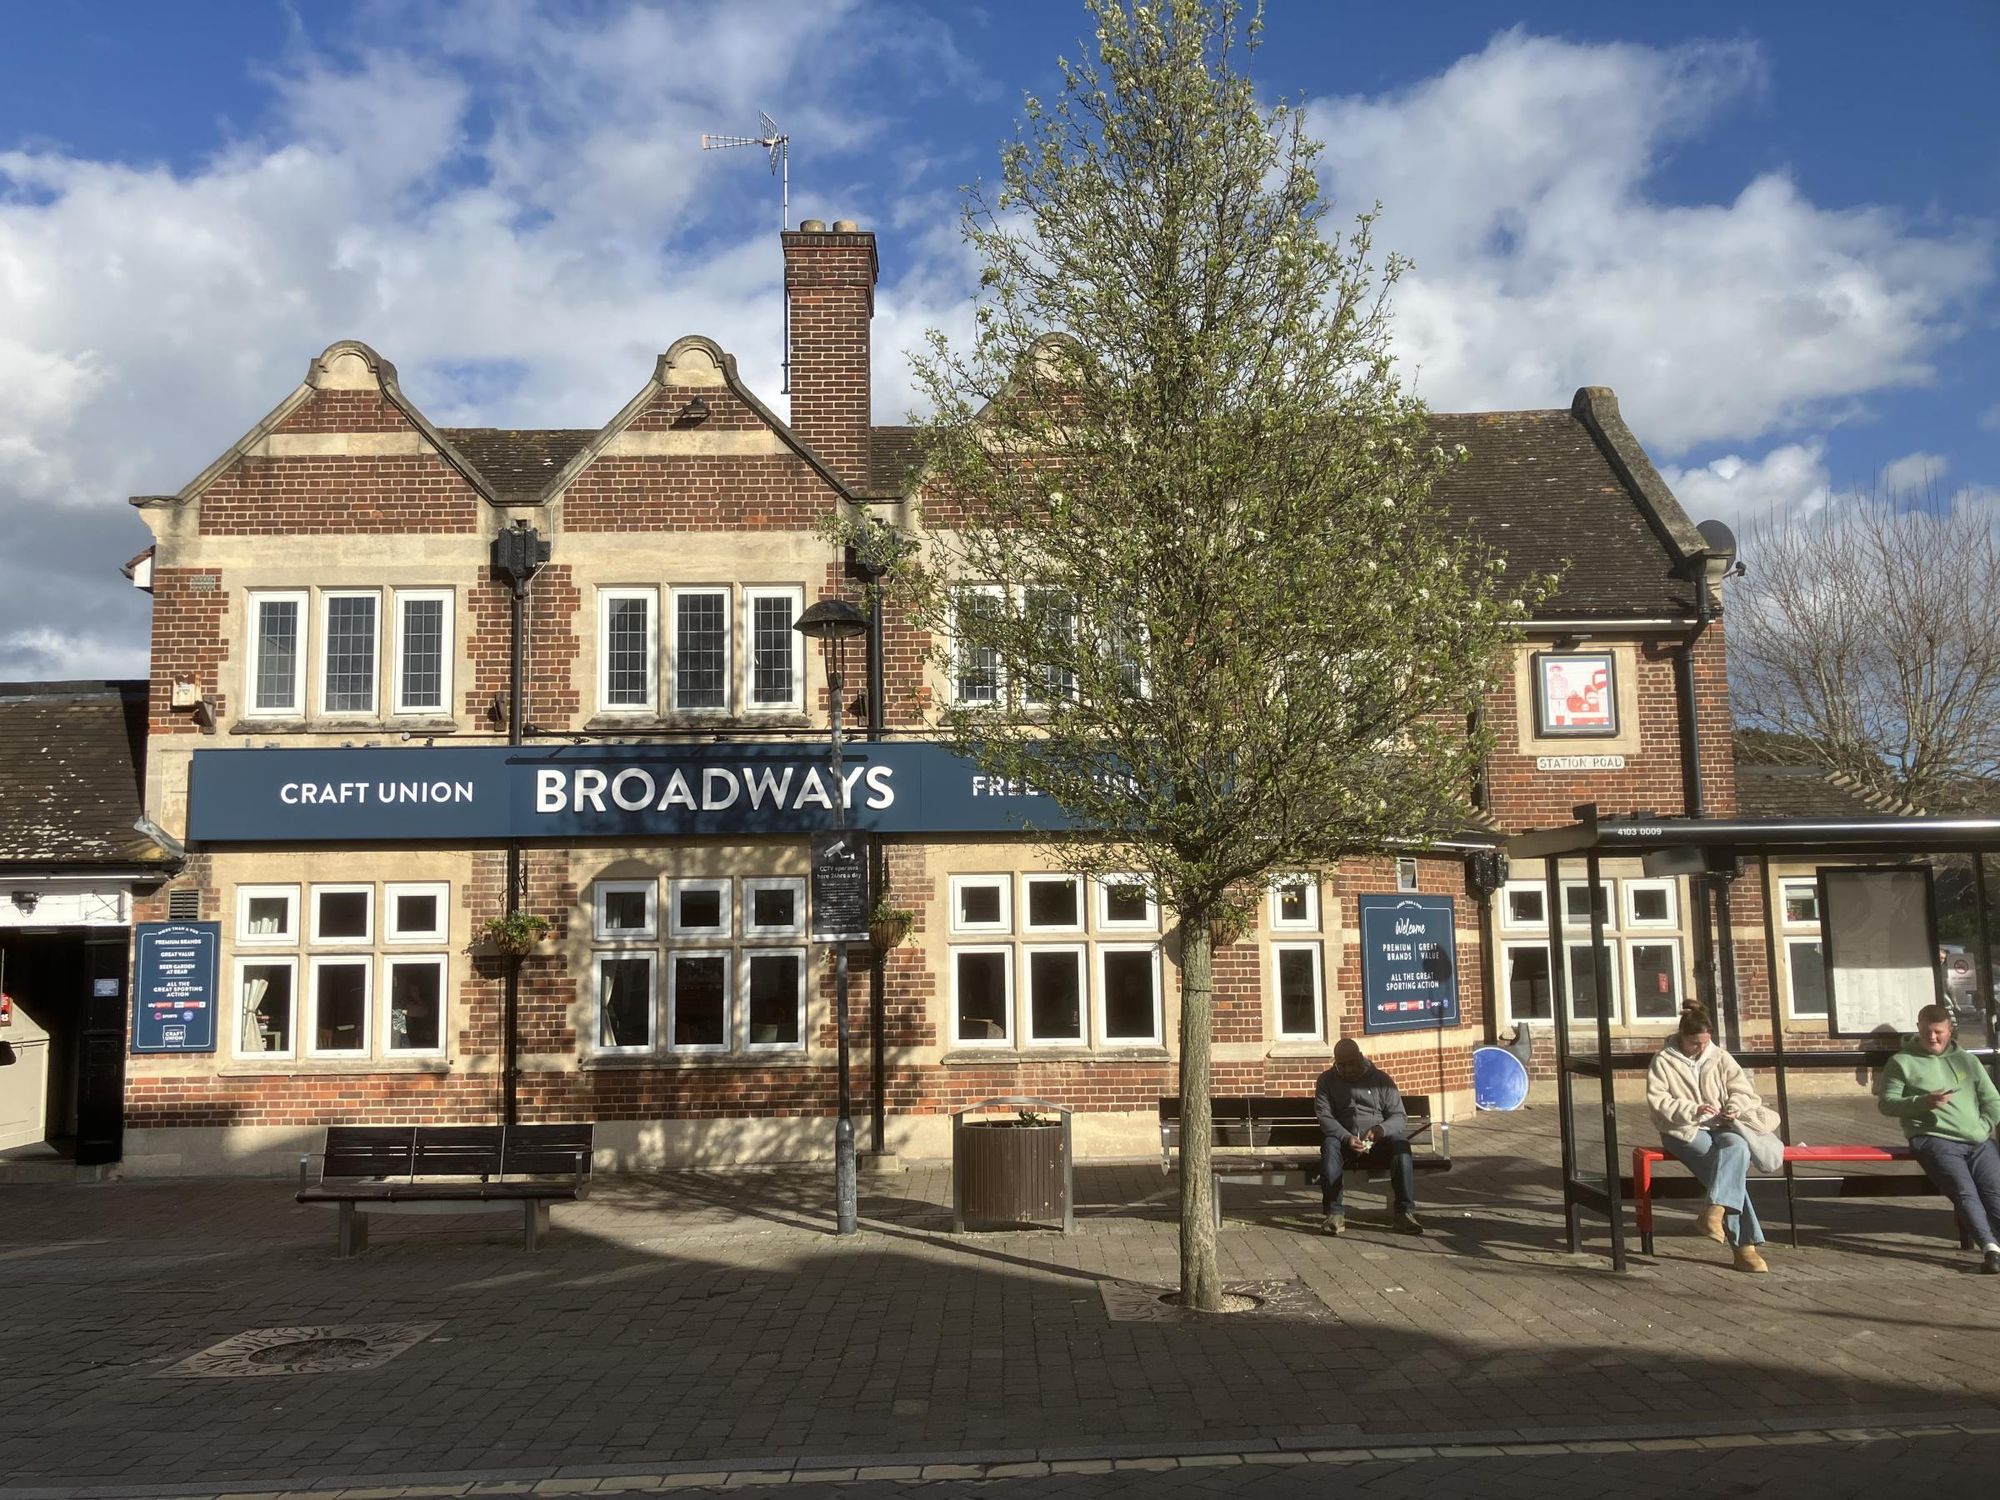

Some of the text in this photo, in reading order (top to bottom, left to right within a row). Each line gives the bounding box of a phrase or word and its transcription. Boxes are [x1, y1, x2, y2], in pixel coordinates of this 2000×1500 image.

[1539, 756, 1622, 768] STATION ROAD
[535, 766, 895, 813] BROADWAYS
[972, 775, 1039, 797] FREE
[280, 781, 474, 804] CRAFT UNION
[1617, 827, 1662, 836] 4103 0009
[1395, 917, 1426, 936] Welcome
[1382, 944, 1412, 952] PREMIUM
[1418, 942, 1438, 950] GREAT
[1387, 952, 1412, 960] BRANDS
[1420, 952, 1440, 960] VALUE
[1390, 972, 1434, 981] ALL THE GREAT
[1386, 980, 1440, 991] SPORTING ACTION
